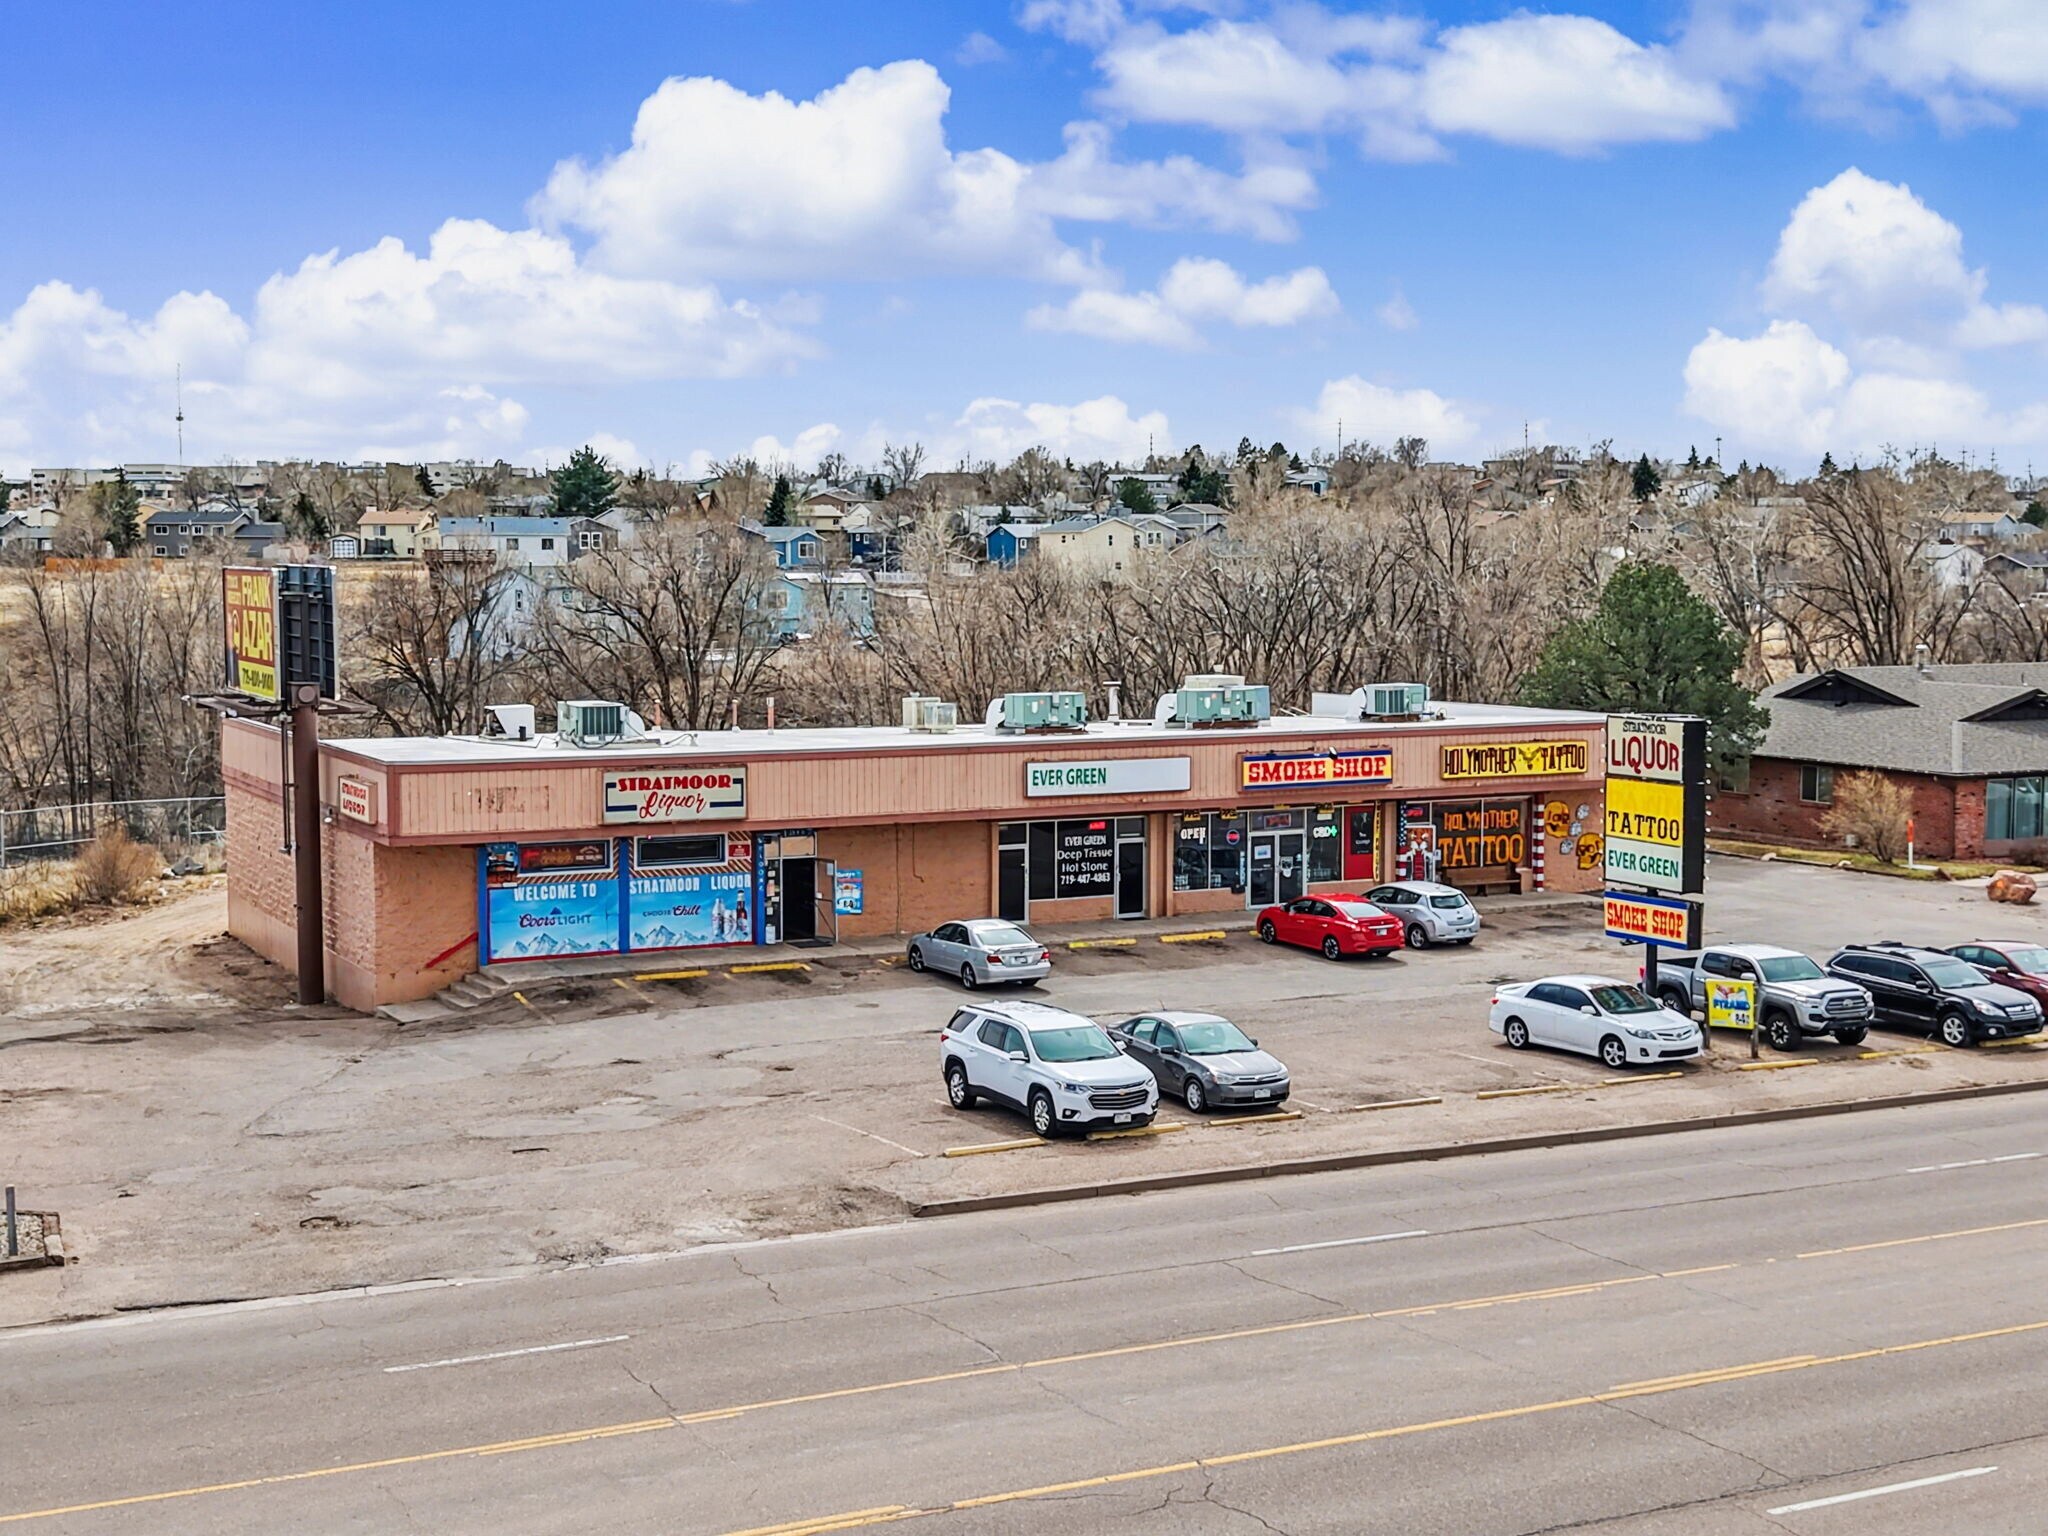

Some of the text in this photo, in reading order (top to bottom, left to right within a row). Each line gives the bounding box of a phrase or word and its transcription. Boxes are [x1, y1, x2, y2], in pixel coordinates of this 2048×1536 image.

[242, 575, 271, 610] FRANK
[242, 609, 273, 662] AZAR
[1541, 744, 1585, 771] TATTOO
[1611, 735, 1679, 774] LIQUOR
[1032, 768, 1107, 786] EVER GREEN
[1248, 756, 1386, 782] SMOKE SHOP
[618, 775, 731, 791] STRATMOOR
[639, 791, 707, 819] Liquor
[1180, 827, 1206, 840] OPEN
[1608, 811, 1680, 841] TATTOO
[1064, 835, 1107, 847] EVER GREEN
[1438, 833, 1524, 867] TATTOO
[1057, 848, 1113, 861] Deep Tissue
[1608, 849, 1679, 878] EVER GREEN
[1062, 861, 1109, 872] Hot Stone
[514, 883, 597, 901] WELCOME TO
[629, 874, 752, 894] STRATMOOR LIQUOR
[520, 913, 592, 928] Coors LIGHT
[673, 904, 701, 916] Chill
[1607, 902, 1684, 938] SMOKE SHOP
